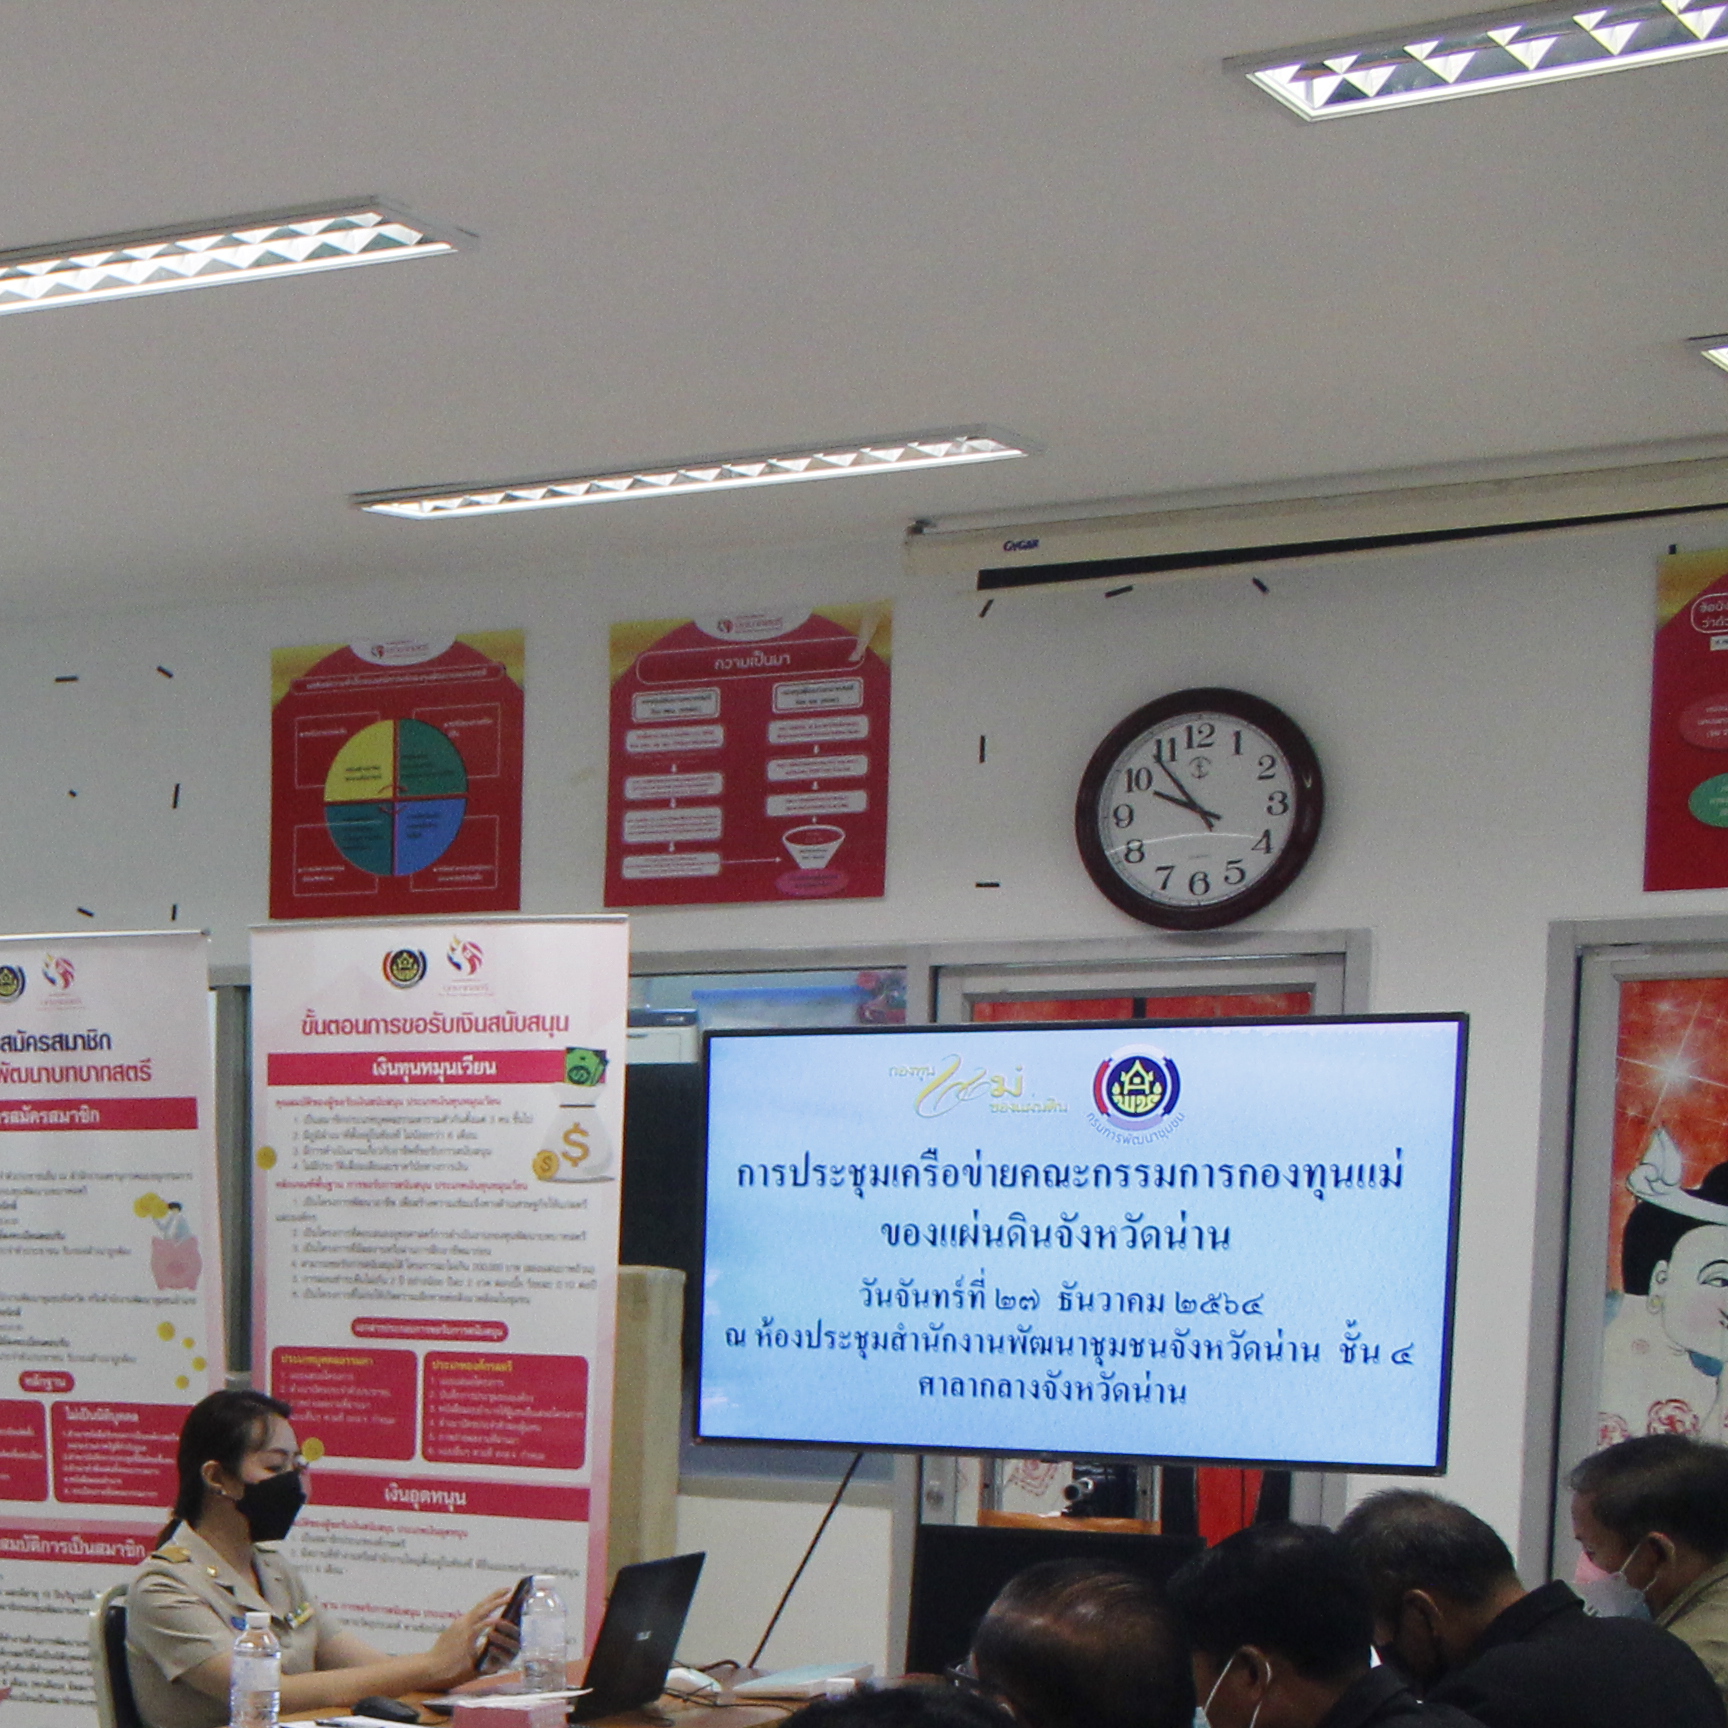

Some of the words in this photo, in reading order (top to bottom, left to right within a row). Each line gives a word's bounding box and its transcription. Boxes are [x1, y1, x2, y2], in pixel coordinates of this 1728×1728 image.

[1185, 723, 1215, 750] 12
[1233, 730, 1243, 756] 1
[1154, 738, 1177, 763] 11
[1125, 767, 1153, 792] 10
[1258, 755, 1276, 780] 2
[1113, 804, 1134, 828] 9
[1267, 790, 1289, 816] 3
[1124, 839, 1145, 863] 8
[1252, 829, 1274, 854] 4
[1155, 865, 1175, 890] 7
[1188, 871, 1210, 896] 6
[1224, 859, 1246, 885] 5
[301, 1008, 570, 1040] ขั้นตอนการขอรับเงินสนับสนุน
[371, 1055, 498, 1083] เงินทุนหมุนเวียน
[1085, 1110, 1186, 1146] กรมการพัฒนาชุมชน
[737, 1147, 1402, 1200] การประชุมเครือข่ายคณะกรรมการกองทุนแม่
[880, 1209, 1230, 1250] ของแผ่นดินจังหวัดน่าน
[859, 1267, 986, 1309] วันจันทร์ที่
[994, 1288, 1040, 1311] ๒๗
[1058, 1280, 1165, 1314] ธันวาคม
[1174, 1290, 1264, 1315] ๒๕๖๔
[725, 1326, 745, 1348] ณ
[755, 1316, 1320, 1366] ห้องประชุมสำนักงานพัฒนาชุมชนจังหวัดน่าน
[1339, 1319, 1380, 1364] ชั้น
[1390, 1342, 1415, 1365] ๔
[918, 1369, 1186, 1404] ศาลากลางจังหวัดน่าน
[384, 1482, 468, 1512] เงินอุดหนุน
